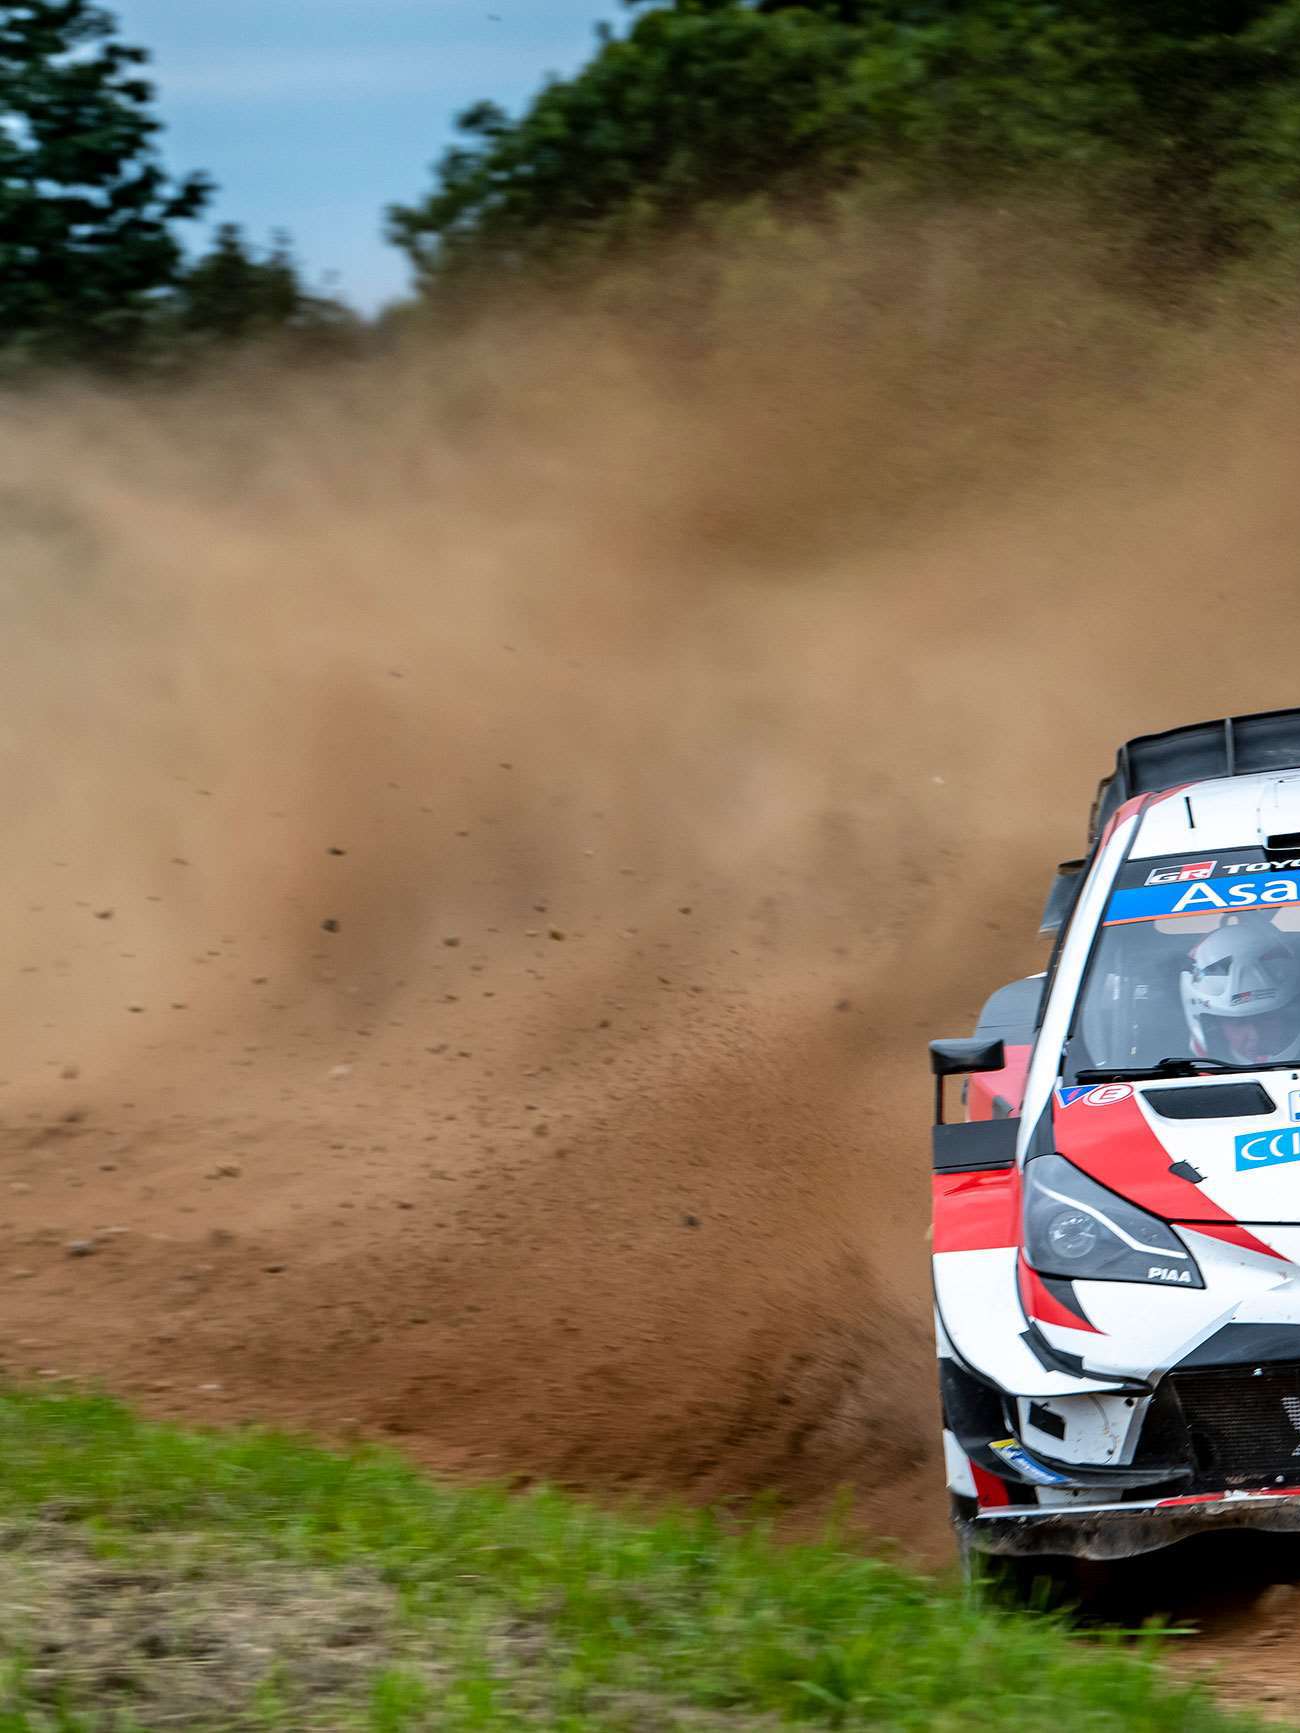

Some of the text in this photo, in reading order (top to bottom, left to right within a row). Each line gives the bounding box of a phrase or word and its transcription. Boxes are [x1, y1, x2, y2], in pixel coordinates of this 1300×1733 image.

[1151, 867, 1211, 884] GR
[1100, 1087, 1122, 1100] E
[1241, 1132, 1300, 1161] CCI
[1147, 1267, 1192, 1283] PIAA
